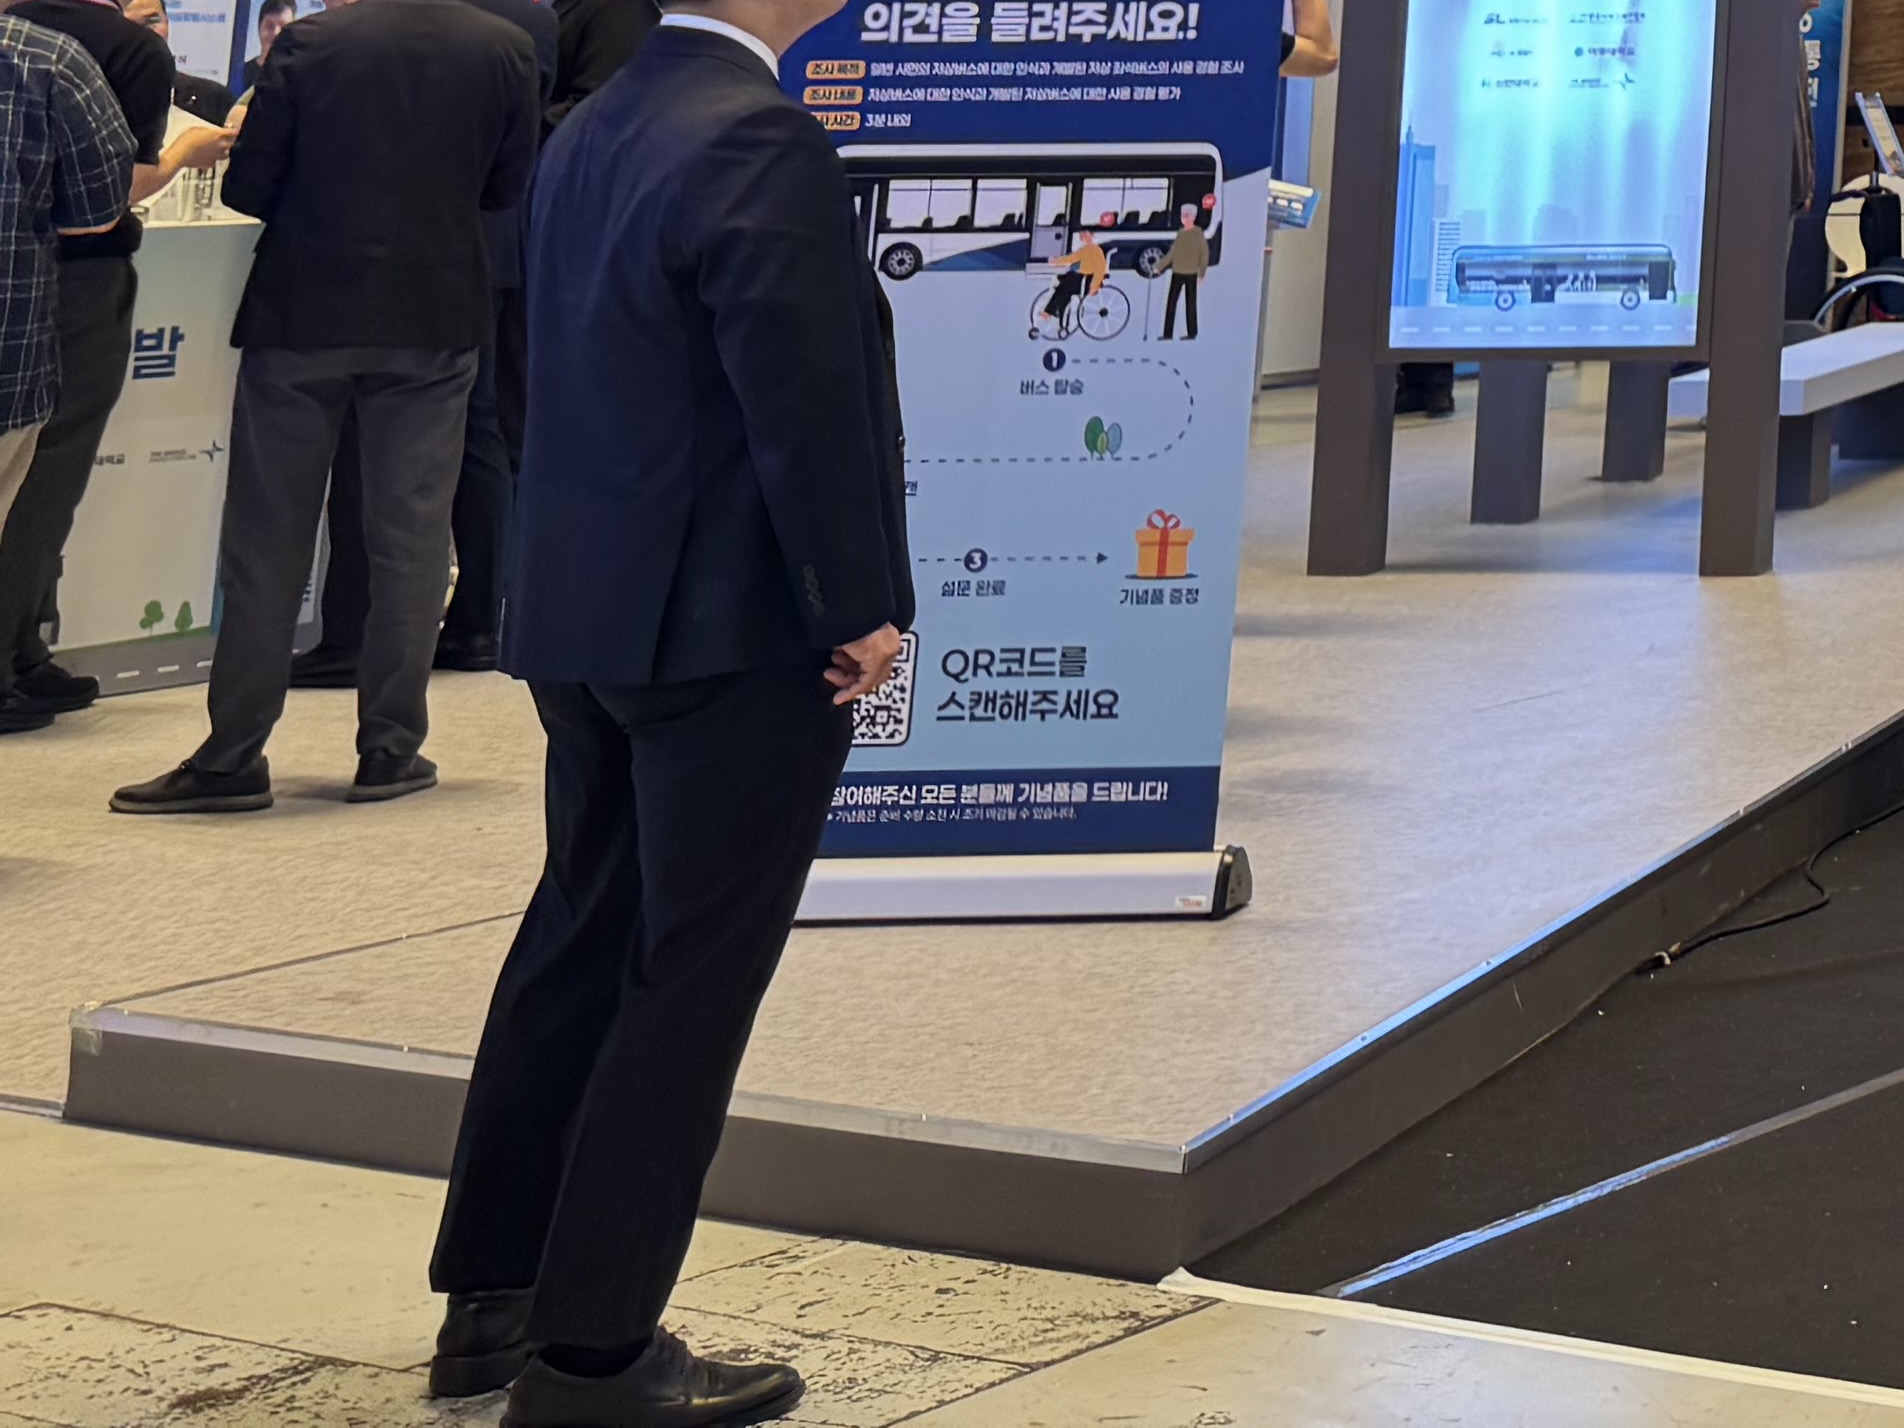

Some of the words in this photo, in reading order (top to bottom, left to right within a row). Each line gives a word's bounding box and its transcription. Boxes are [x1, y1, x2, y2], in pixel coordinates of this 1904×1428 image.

[861, 2, 981, 43] 의견을
[990, 1, 1199, 42] 들려주세요!
[132, 326, 185, 381] 발
[1020, 379, 1050, 396] 버스
[1054, 378, 1084, 396] 탑승
[1119, 588, 1165, 606] 기념품
[941, 645, 1088, 684] QR코드를
[936, 689, 1120, 723] 스캔해주세요
[830, 785, 918, 807] 참여해주신
[920, 784, 957, 806] 모든
[1017, 782, 1089, 804] 기념품을
[1090, 781, 1169, 803] 드립니다!
